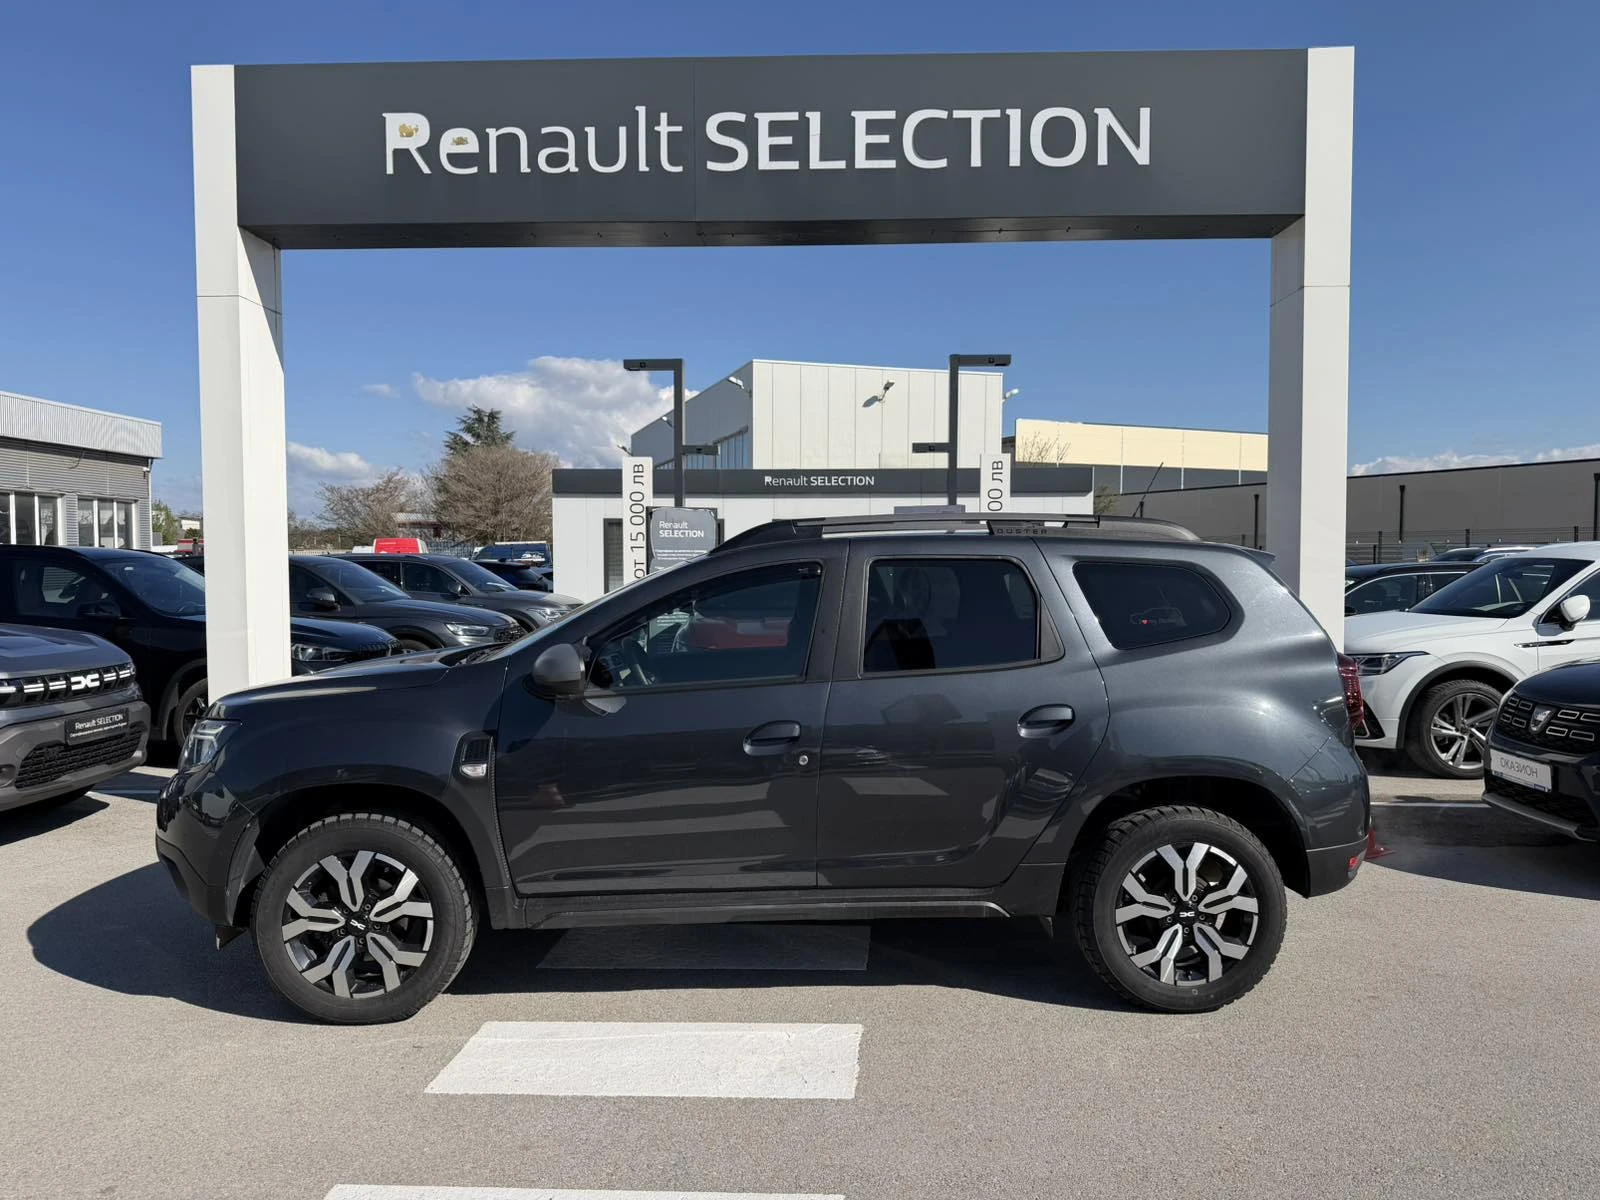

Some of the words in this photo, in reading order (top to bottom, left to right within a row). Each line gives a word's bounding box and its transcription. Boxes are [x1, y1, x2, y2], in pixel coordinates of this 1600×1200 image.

[383, 105, 684, 175] Renault
[705, 106, 1152, 172] SELECTION
[764, 475, 808, 486] Renault
[810, 476, 875, 486] SELECTION
[629, 491, 645, 526] 000
[659, 520, 688, 529] Renault
[659, 529, 705, 538] SELECTION
[630, 531, 645, 553] 15
